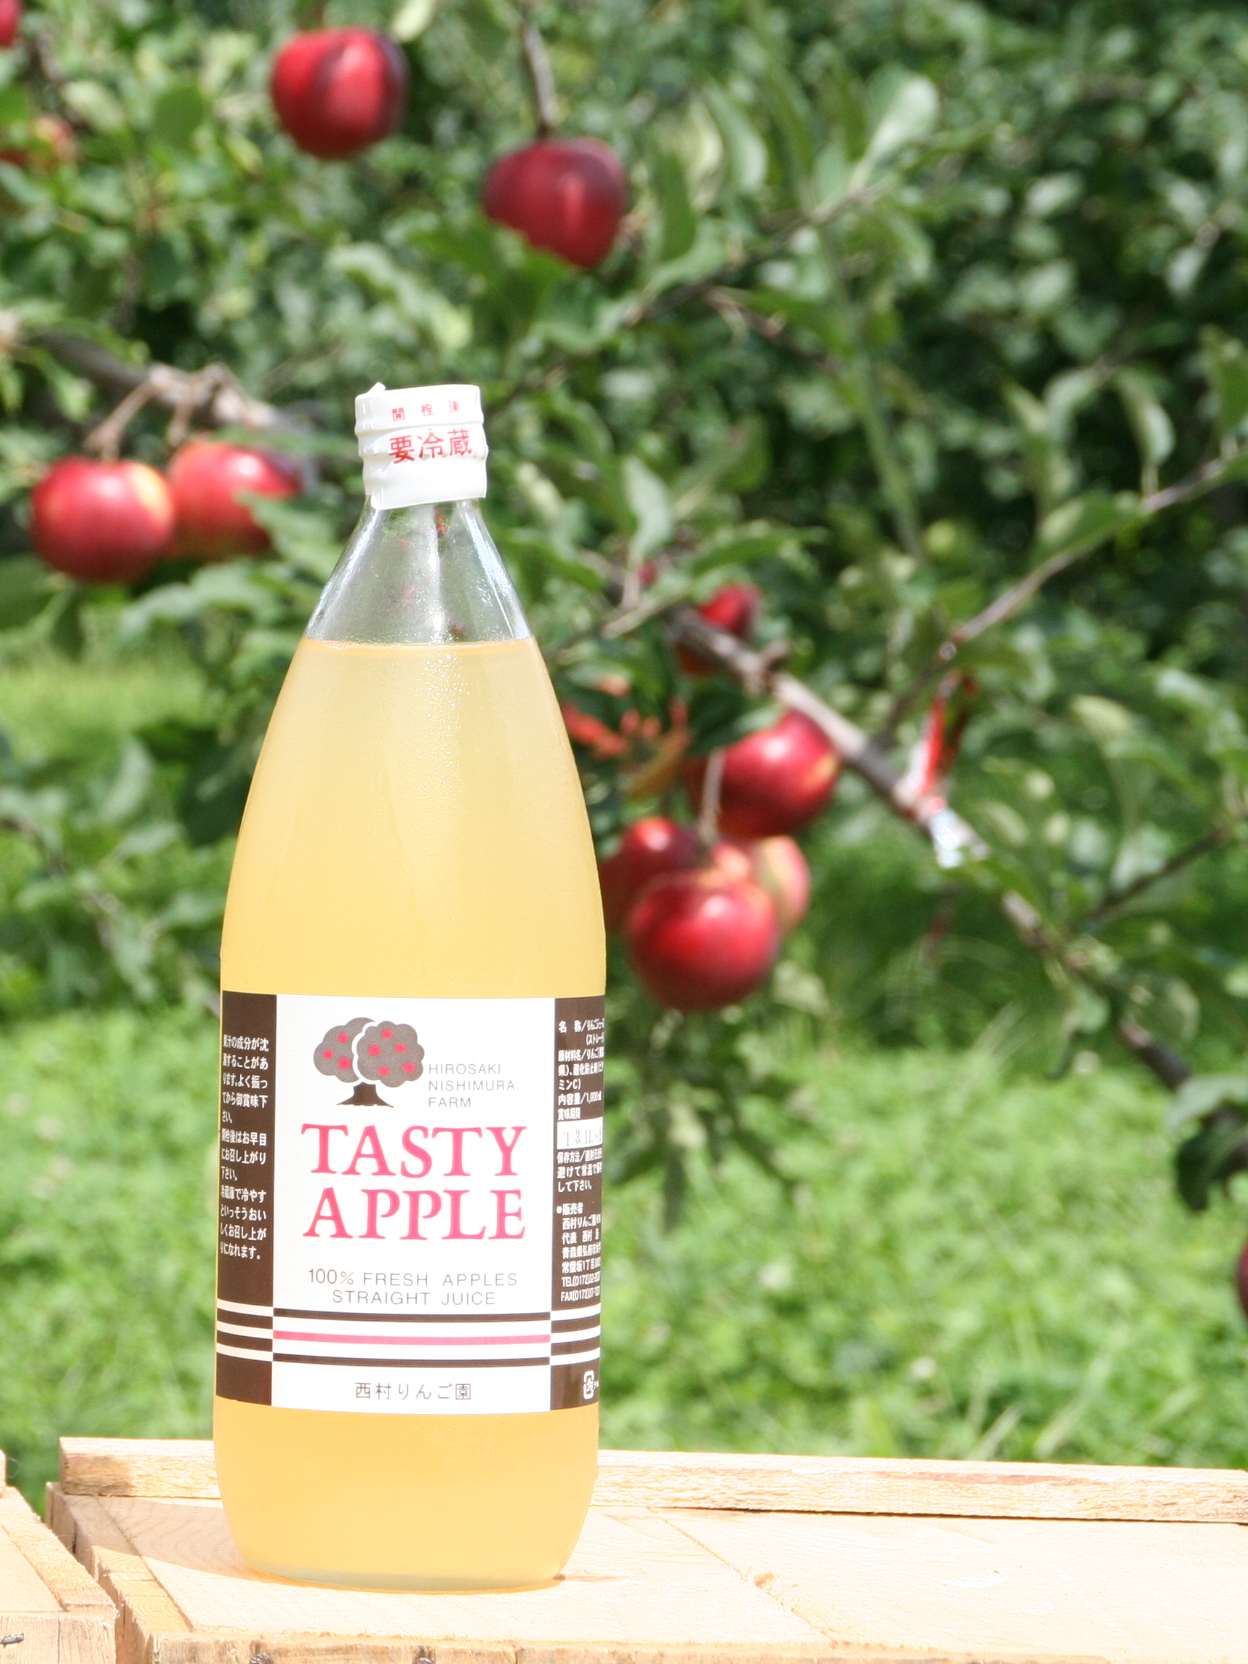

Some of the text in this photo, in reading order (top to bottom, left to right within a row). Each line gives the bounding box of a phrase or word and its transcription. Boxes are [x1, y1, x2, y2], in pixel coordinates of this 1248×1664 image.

[392, 400, 460, 422] 開栓後
[389, 428, 473, 464] 要冷蔵
[428, 1063, 501, 1075] HIROSAKI
[428, 1080, 515, 1092] NISHIMURA
[428, 1096, 471, 1109] FARM
[301, 1123, 527, 1178] TASTY
[302, 1187, 525, 1240] APPLE
[308, 1268, 517, 1287] 100% FRESH APPLES
[332, 1290, 495, 1305] STRAIGHT JUICE
[355, 1382, 471, 1401] 西村りんご園
